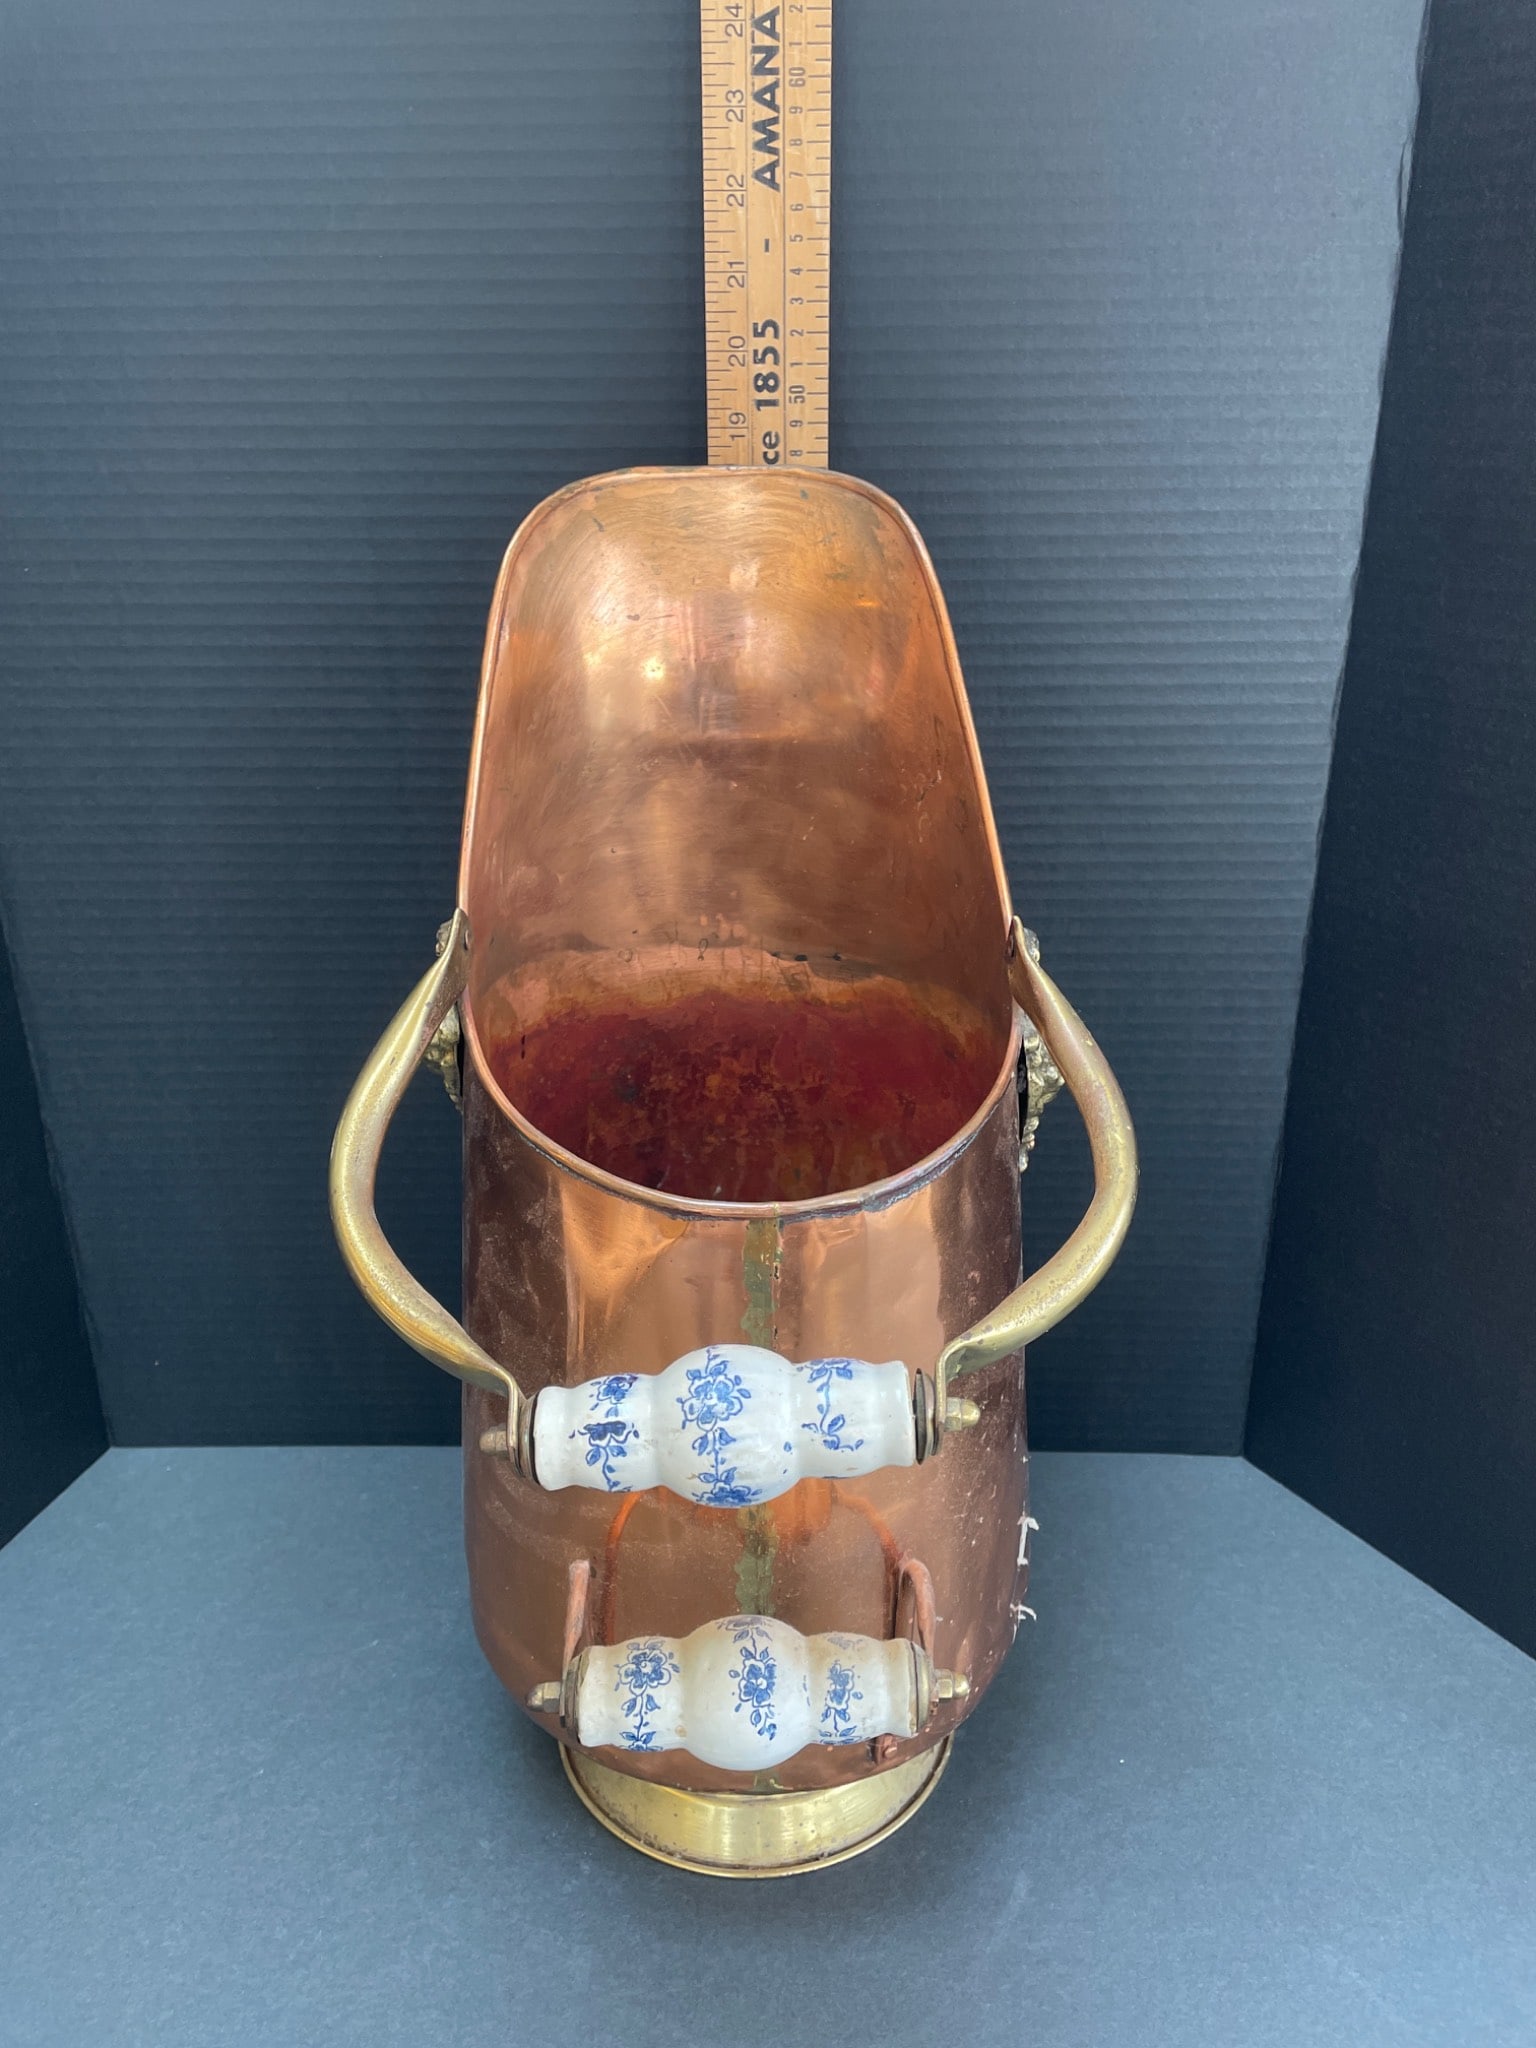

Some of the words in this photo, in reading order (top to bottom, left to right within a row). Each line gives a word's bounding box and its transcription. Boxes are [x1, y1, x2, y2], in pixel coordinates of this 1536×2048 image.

[724, 3, 743, 38] 24
[788, 67, 806, 88] 60
[725, 89, 744, 123] 23
[751, 5, 781, 193] AMANA
[788, 106, 803, 114] 9
[789, 138, 803, 147] 8
[789, 171, 804, 179] 7
[726, 174, 744, 207] 22
[790, 203, 804, 212] 6
[789, 234, 804, 243] 5
[727, 261, 745, 288] 21
[789, 267, 804, 275] 4
[789, 297, 804, 305] 3
[789, 329, 804, 337] 2
[728, 335, 746, 367] 20
[752, 319, 780, 412] 1855
[788, 385, 805, 404] 50
[728, 412, 746, 441] 19
[789, 419, 804, 428] 9
[789, 449, 803, 457] 8
